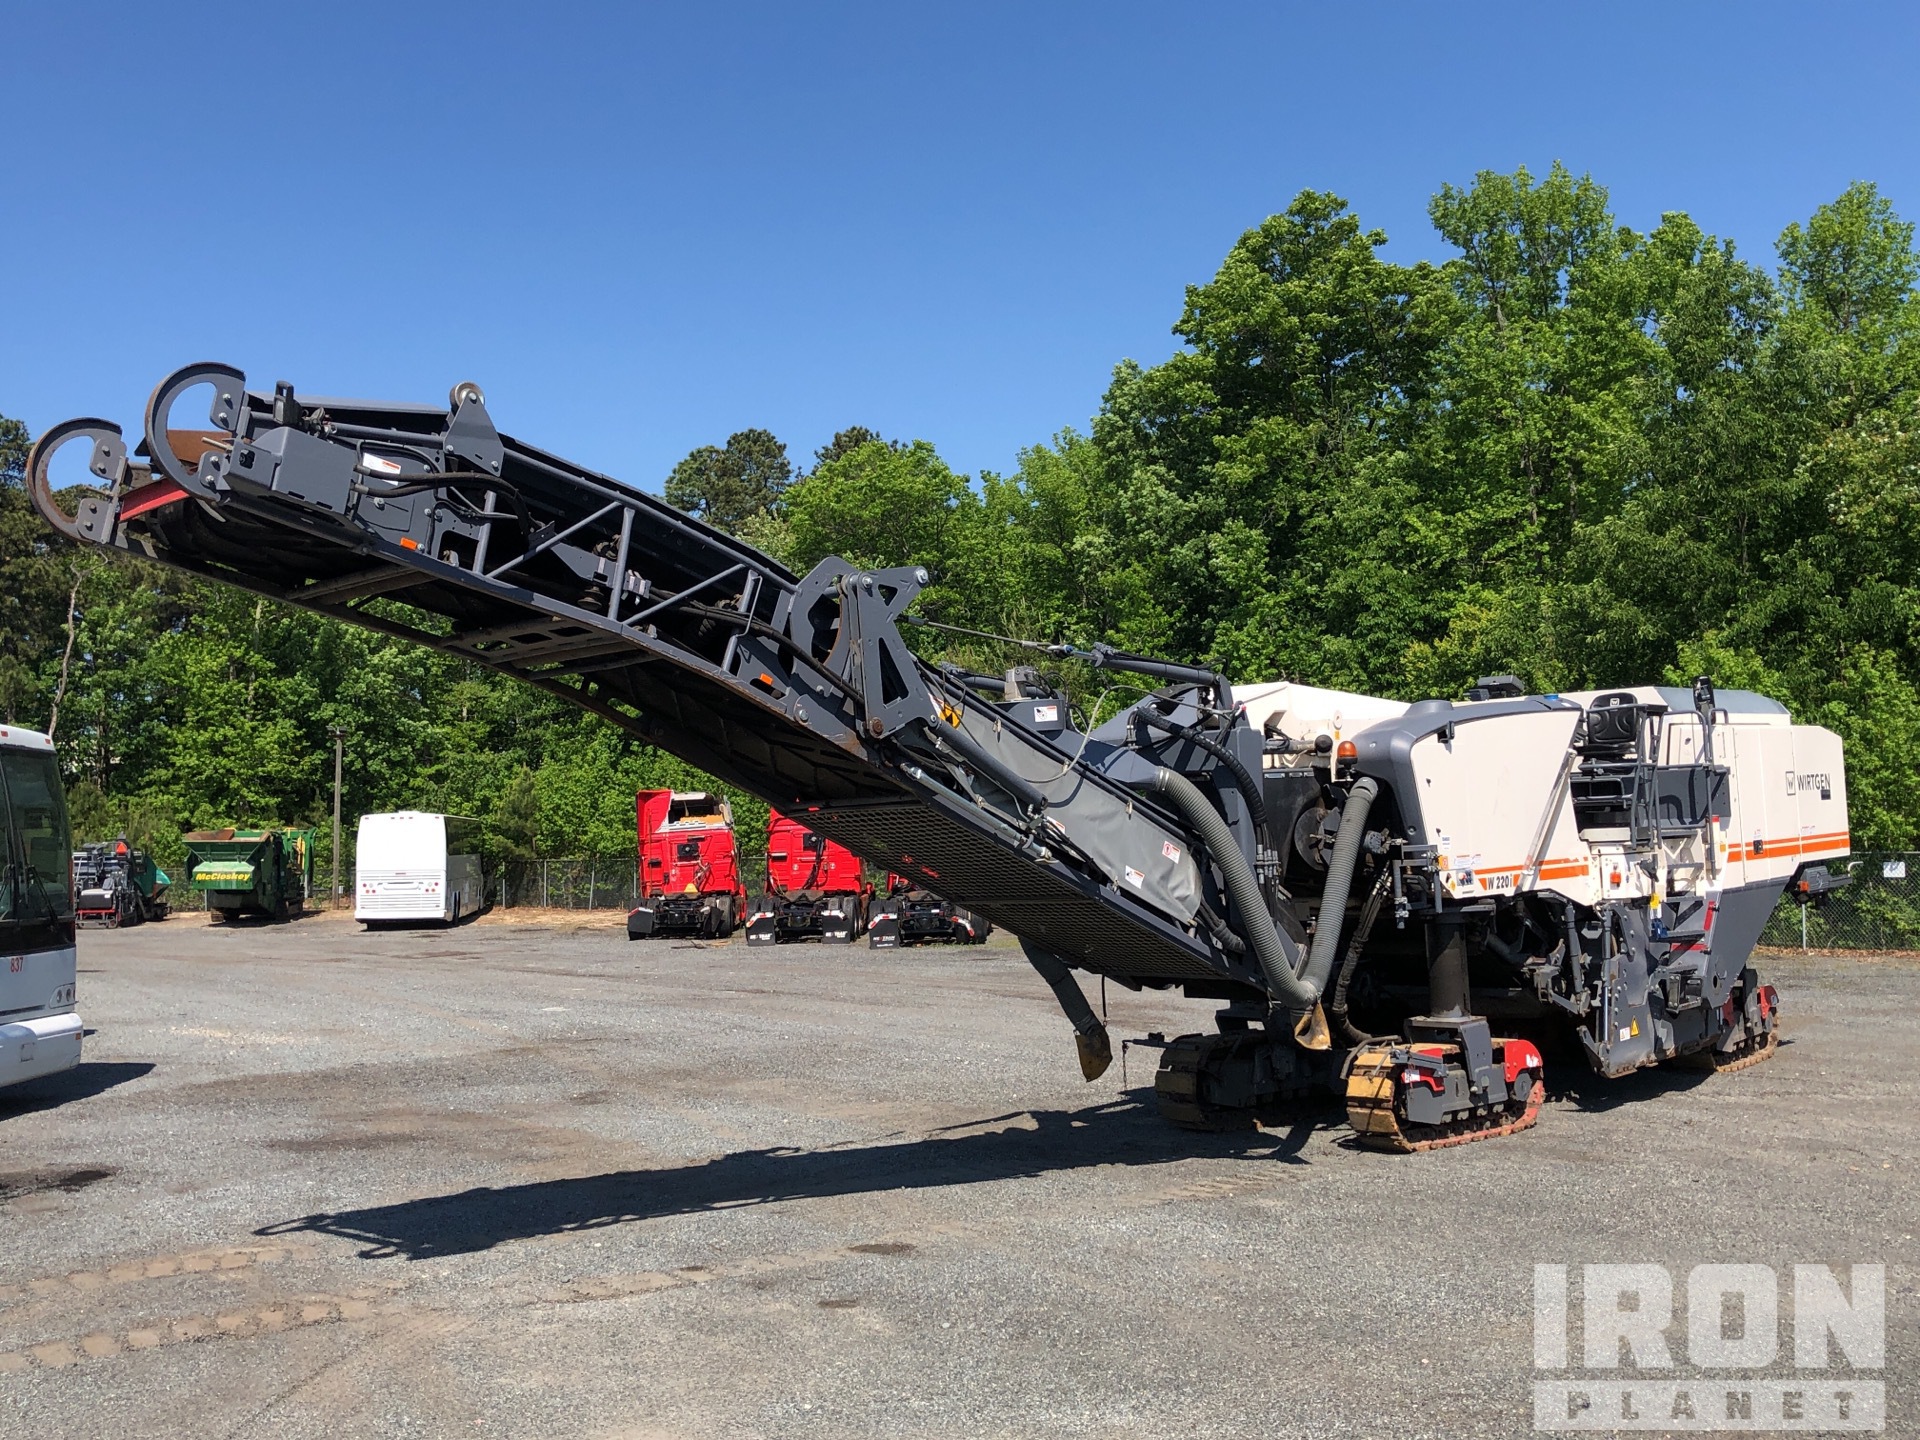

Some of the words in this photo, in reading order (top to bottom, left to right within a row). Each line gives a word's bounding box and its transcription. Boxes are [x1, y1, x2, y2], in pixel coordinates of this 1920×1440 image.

[1797, 773, 1831, 791] WIRTGEN
[195, 872, 250, 881] McCloskey
[1488, 876, 1495, 890] W
[1496, 874, 1512, 890] 220i
[10, 957, 24, 973] 837
